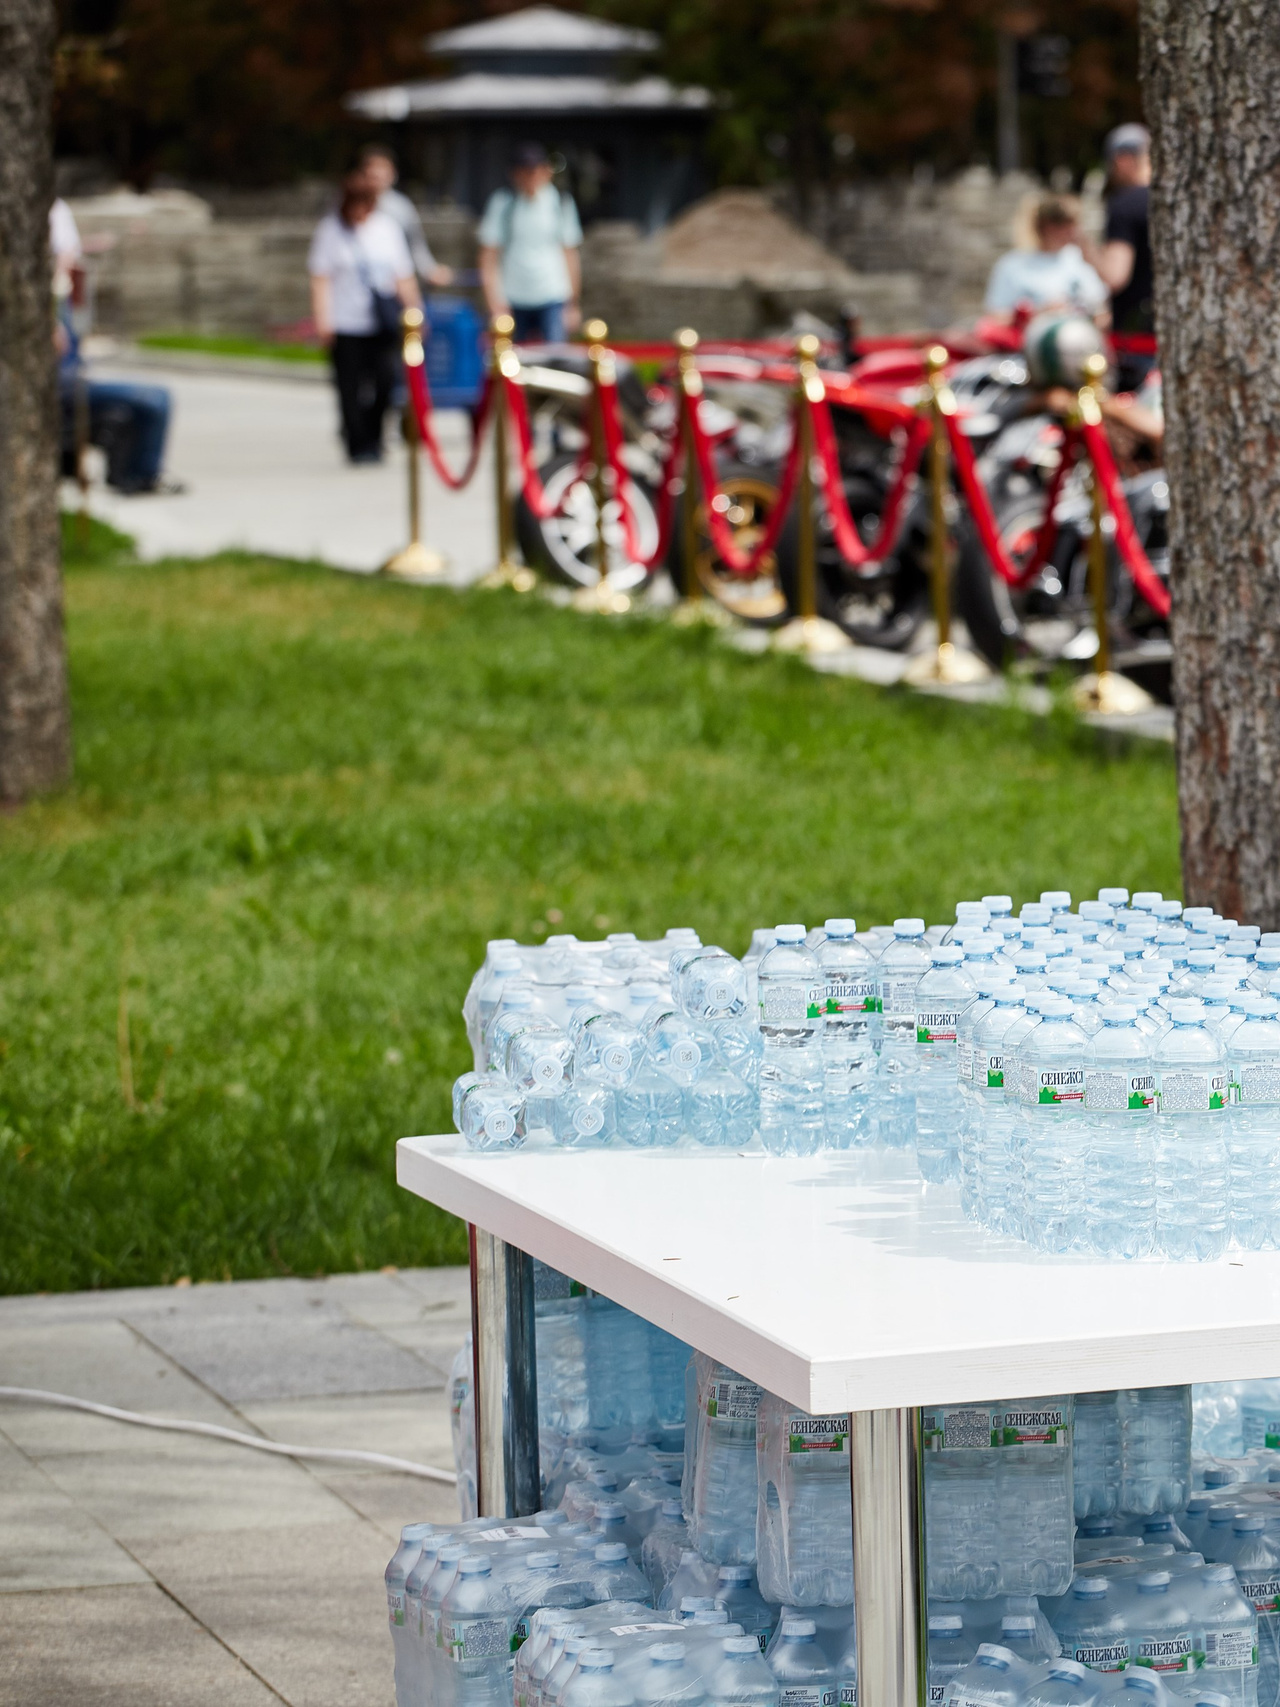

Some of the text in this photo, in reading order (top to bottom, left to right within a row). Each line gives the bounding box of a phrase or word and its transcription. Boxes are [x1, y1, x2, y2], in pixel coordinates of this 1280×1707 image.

[825, 984, 875, 998] СЕНЕЖСКАЯ
[1041, 1071, 1083, 1085] СЕНЕЖС
[1004, 1411, 1062, 1426] СЕНЕЖСКАЯ
[790, 1419, 848, 1434] СЕНЕЖСКАЯ
[1075, 1645, 1129, 1663] СЕНЕЖСКАЯ
[1138, 1638, 1191, 1656] СЕНЕЖСКАЯ
